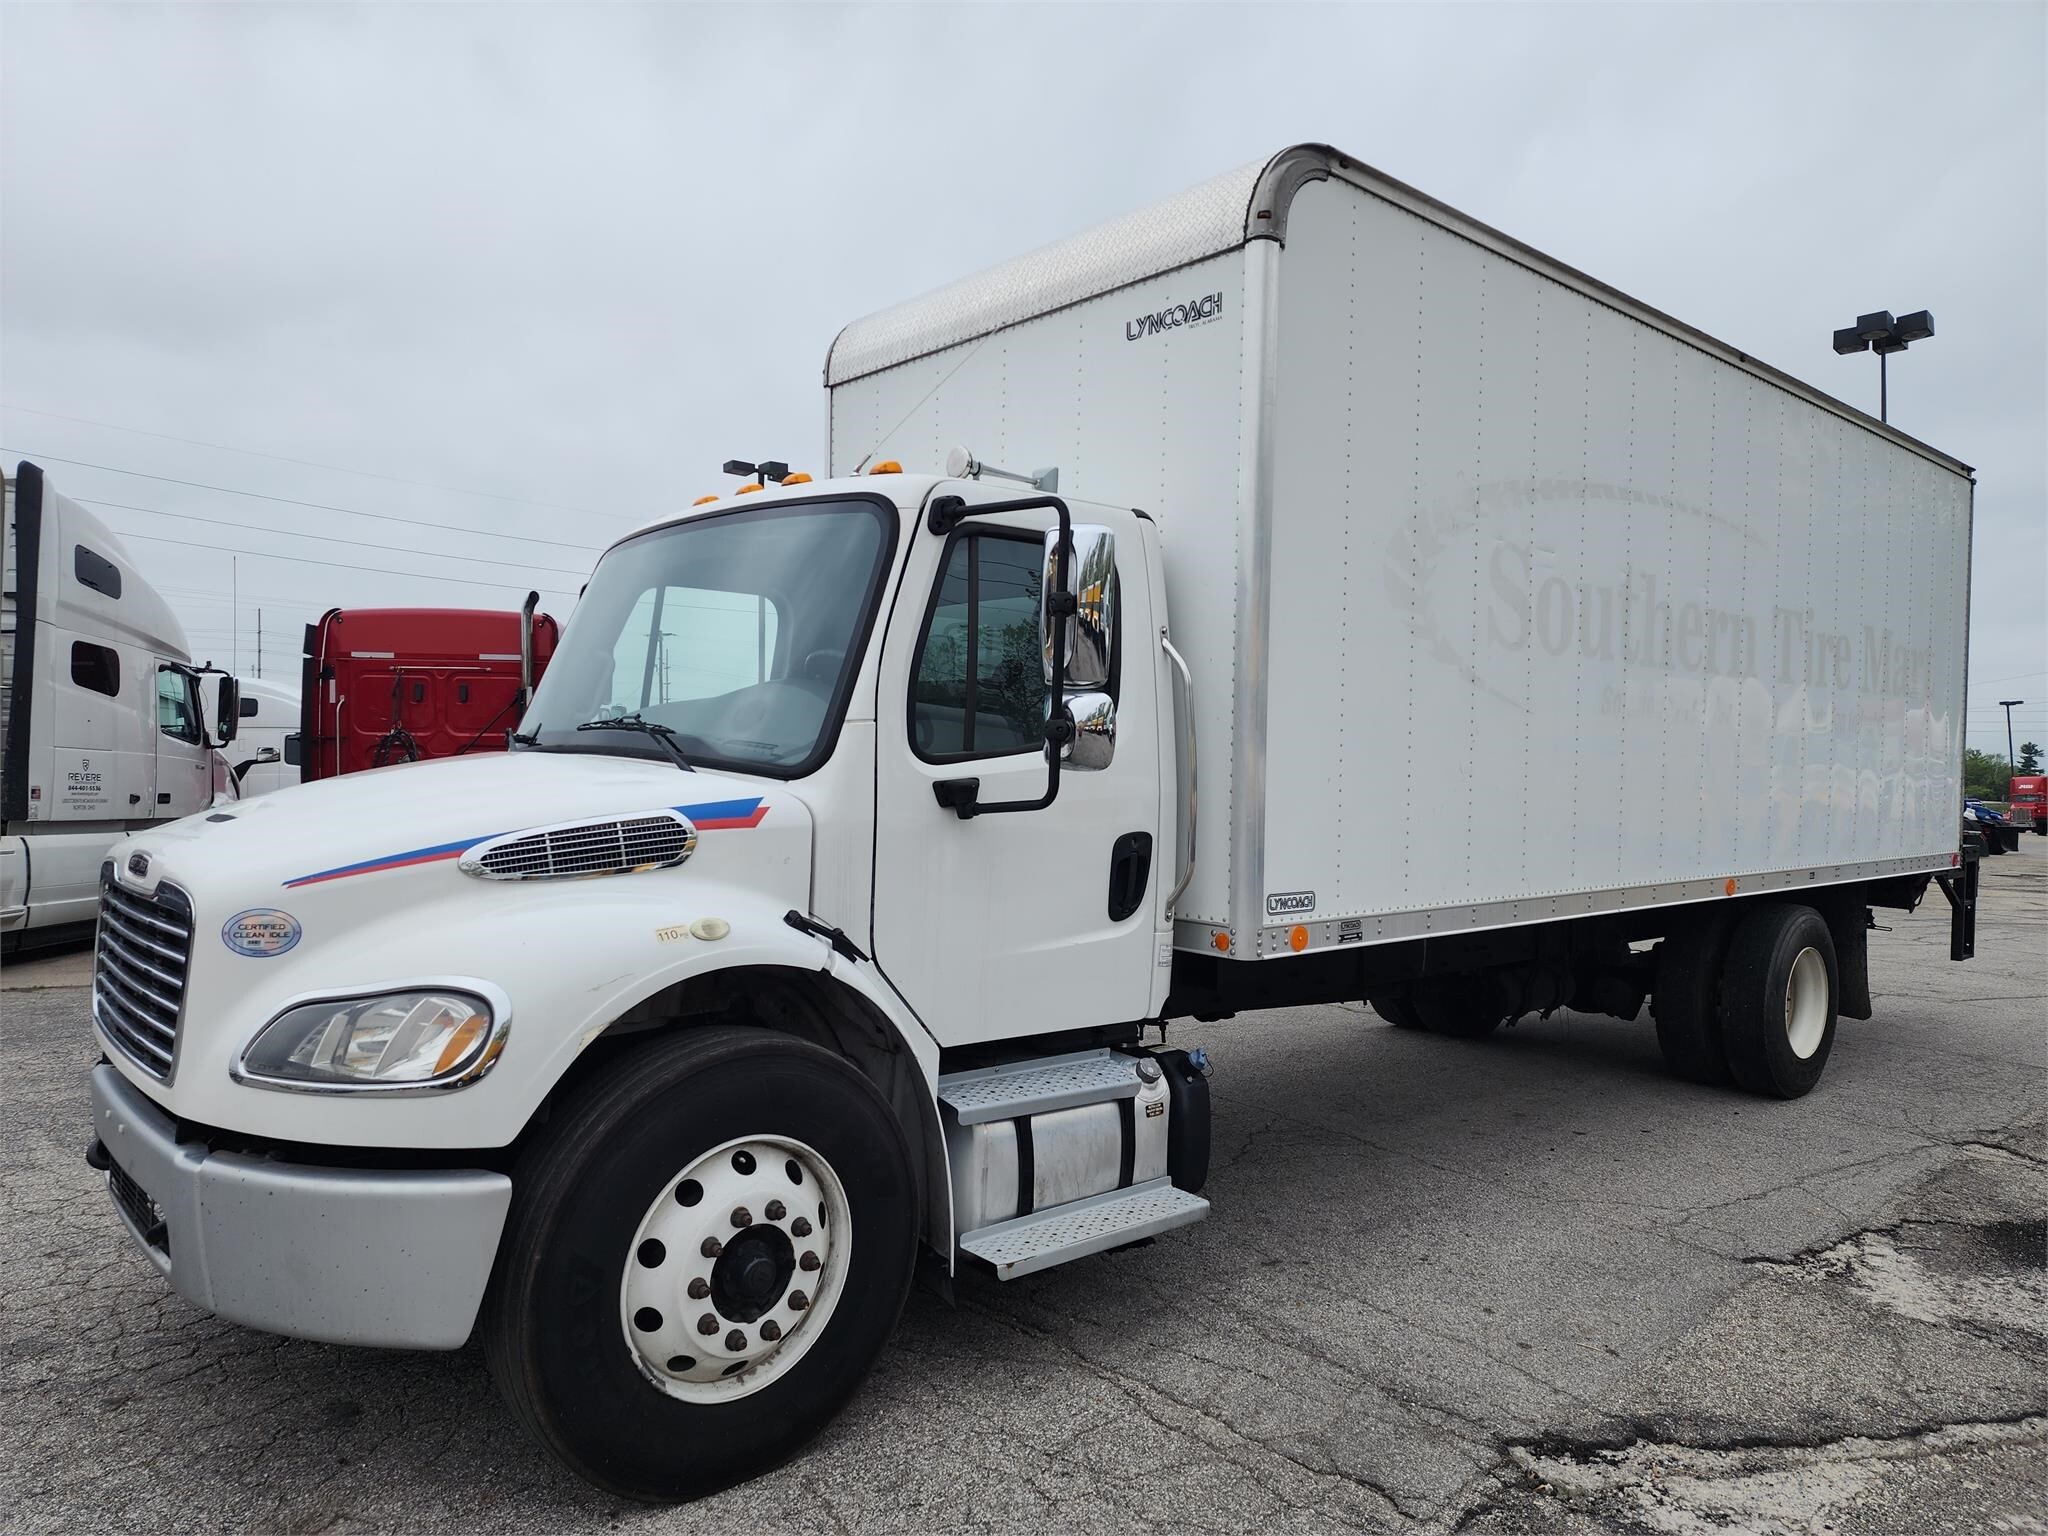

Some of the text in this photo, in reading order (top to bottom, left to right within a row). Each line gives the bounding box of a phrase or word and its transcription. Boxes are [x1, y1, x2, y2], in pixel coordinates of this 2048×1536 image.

[1126, 291, 1223, 341] LYNCOACH
[1487, 541, 1758, 678] Southern
[1773, 603, 1852, 690] Tire
[68, 772, 102, 782] REVERE
[1269, 895, 1313, 910] LYNCOACH
[237, 923, 286, 931] CERTIFIED
[233, 931, 265, 939] CLEAN
[658, 929, 679, 941] 110
